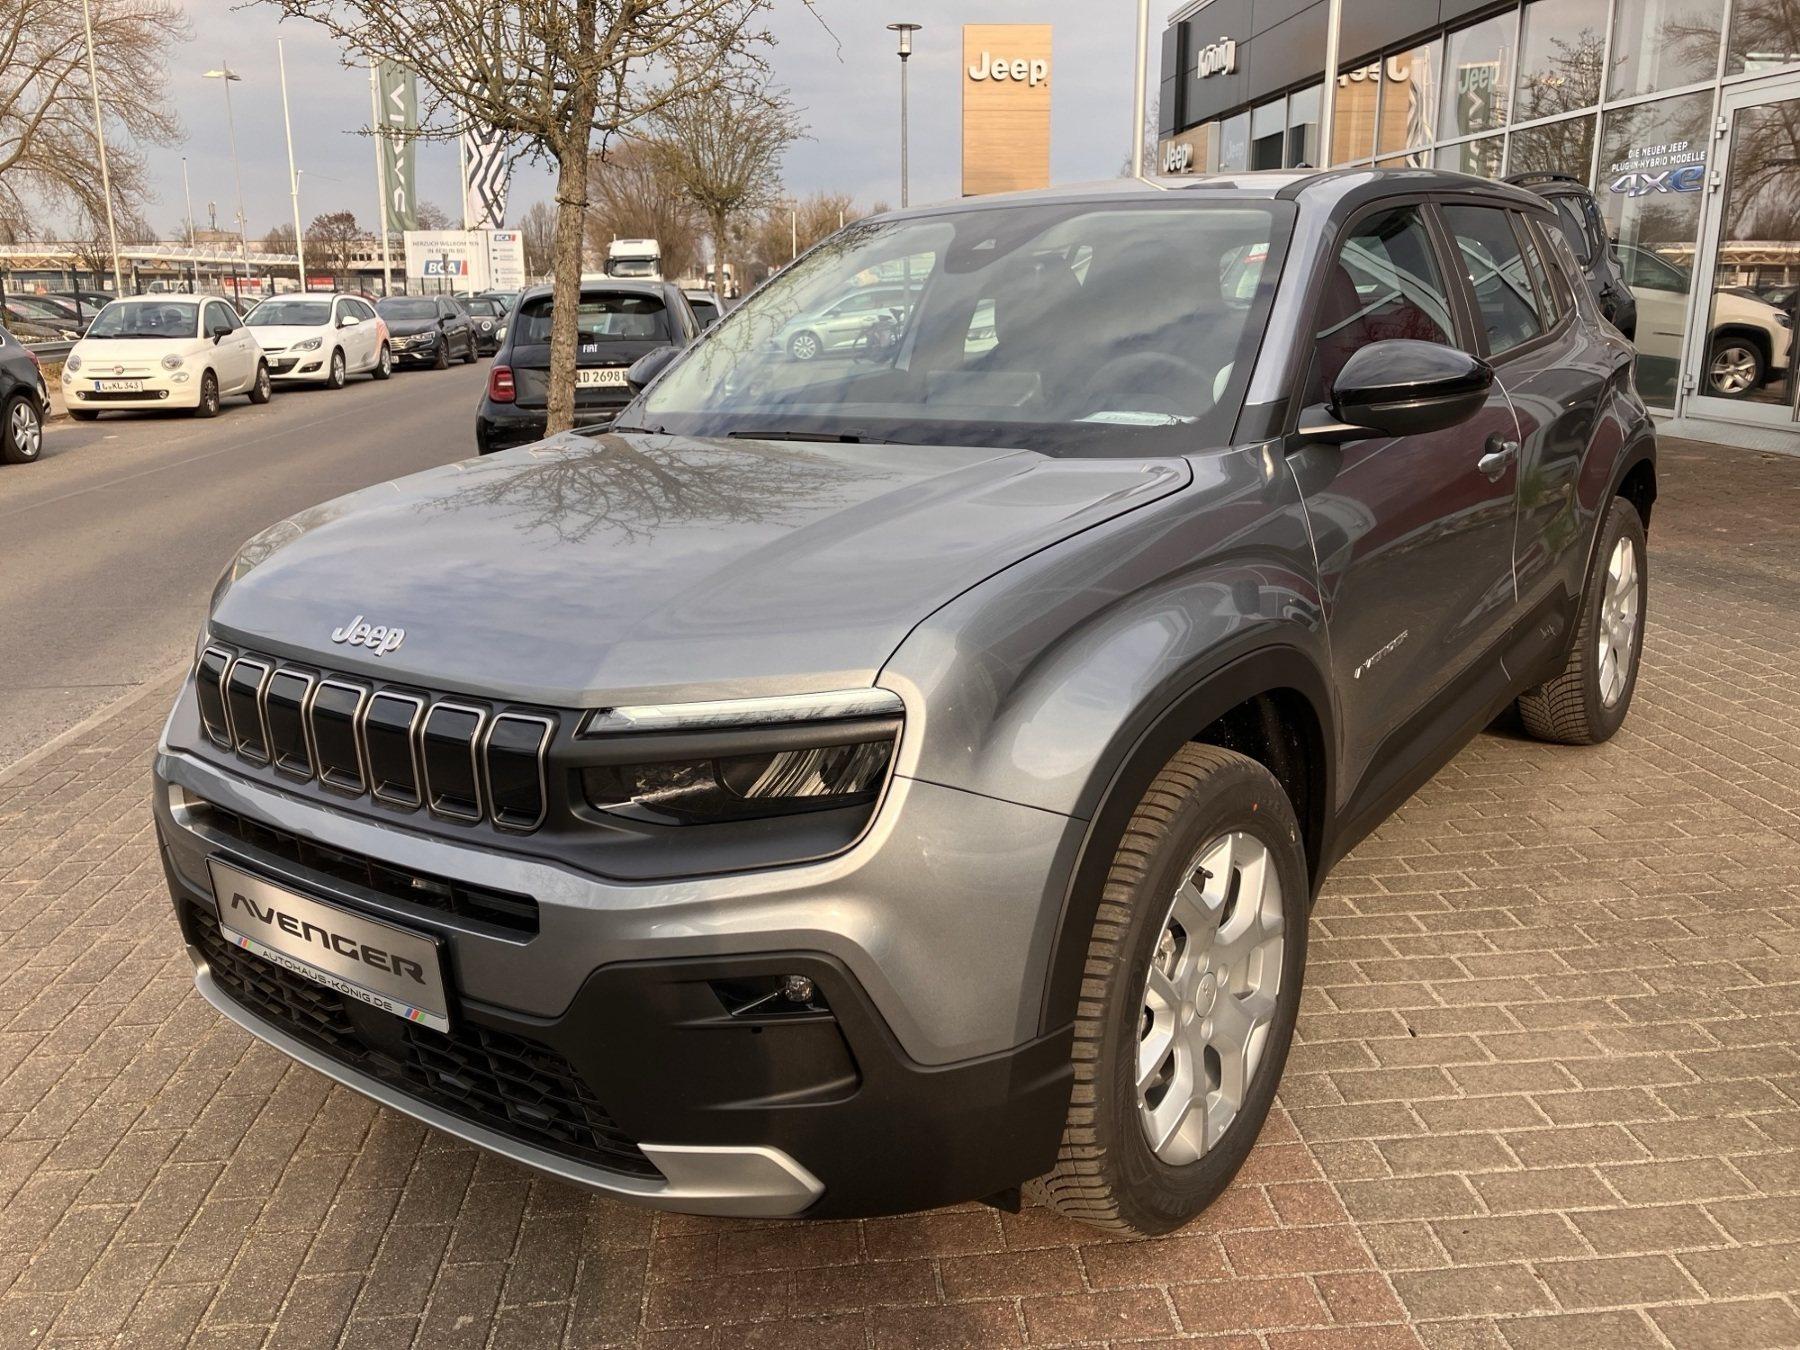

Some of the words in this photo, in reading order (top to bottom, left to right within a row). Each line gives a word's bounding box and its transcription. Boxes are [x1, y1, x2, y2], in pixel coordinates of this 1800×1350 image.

[967, 48, 1048, 87] Jeep
[1458, 63, 1500, 94] Jeep
[1163, 141, 1192, 174] Jeep
[1642, 145, 1666, 157] NEUEN
[1668, 141, 1688, 153] JEEP
[1670, 151, 1706, 164] MODELLE
[428, 262, 457, 274] BCA
[583, 344, 598, 353] FIAT
[331, 614, 407, 656] Jeep
[231, 892, 427, 985] AVENGER
